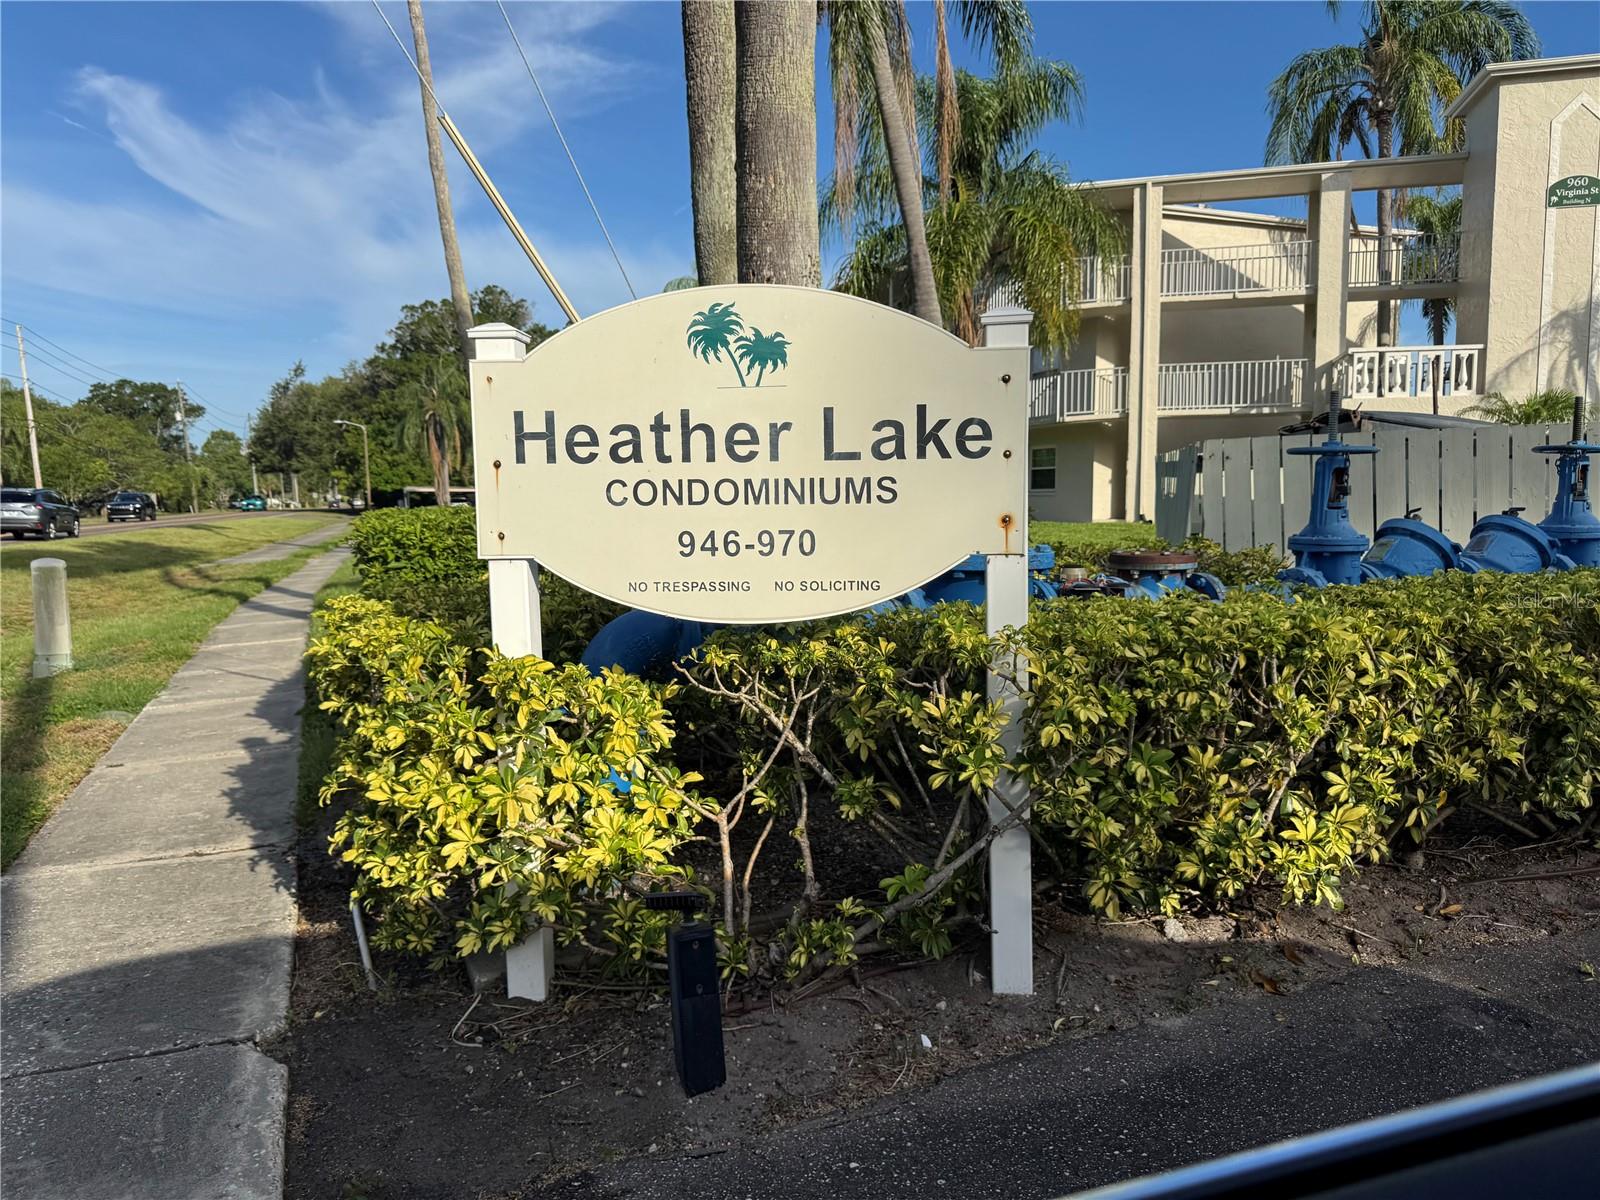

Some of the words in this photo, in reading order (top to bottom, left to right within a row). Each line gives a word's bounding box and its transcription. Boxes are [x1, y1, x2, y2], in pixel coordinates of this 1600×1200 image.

[1556, 188, 1589, 197] Virginia
[1567, 177, 1589, 187] 960
[513, 408, 793, 465] Heather
[823, 403, 993, 462] Lake
[605, 475, 898, 507] CONDOMINIUMS
[677, 529, 816, 558] 946-970
[628, 581, 648, 593] NO
[653, 581, 751, 593] TRESPASSING
[774, 580, 795, 592] NO
[799, 580, 881, 592] SOLICITING
